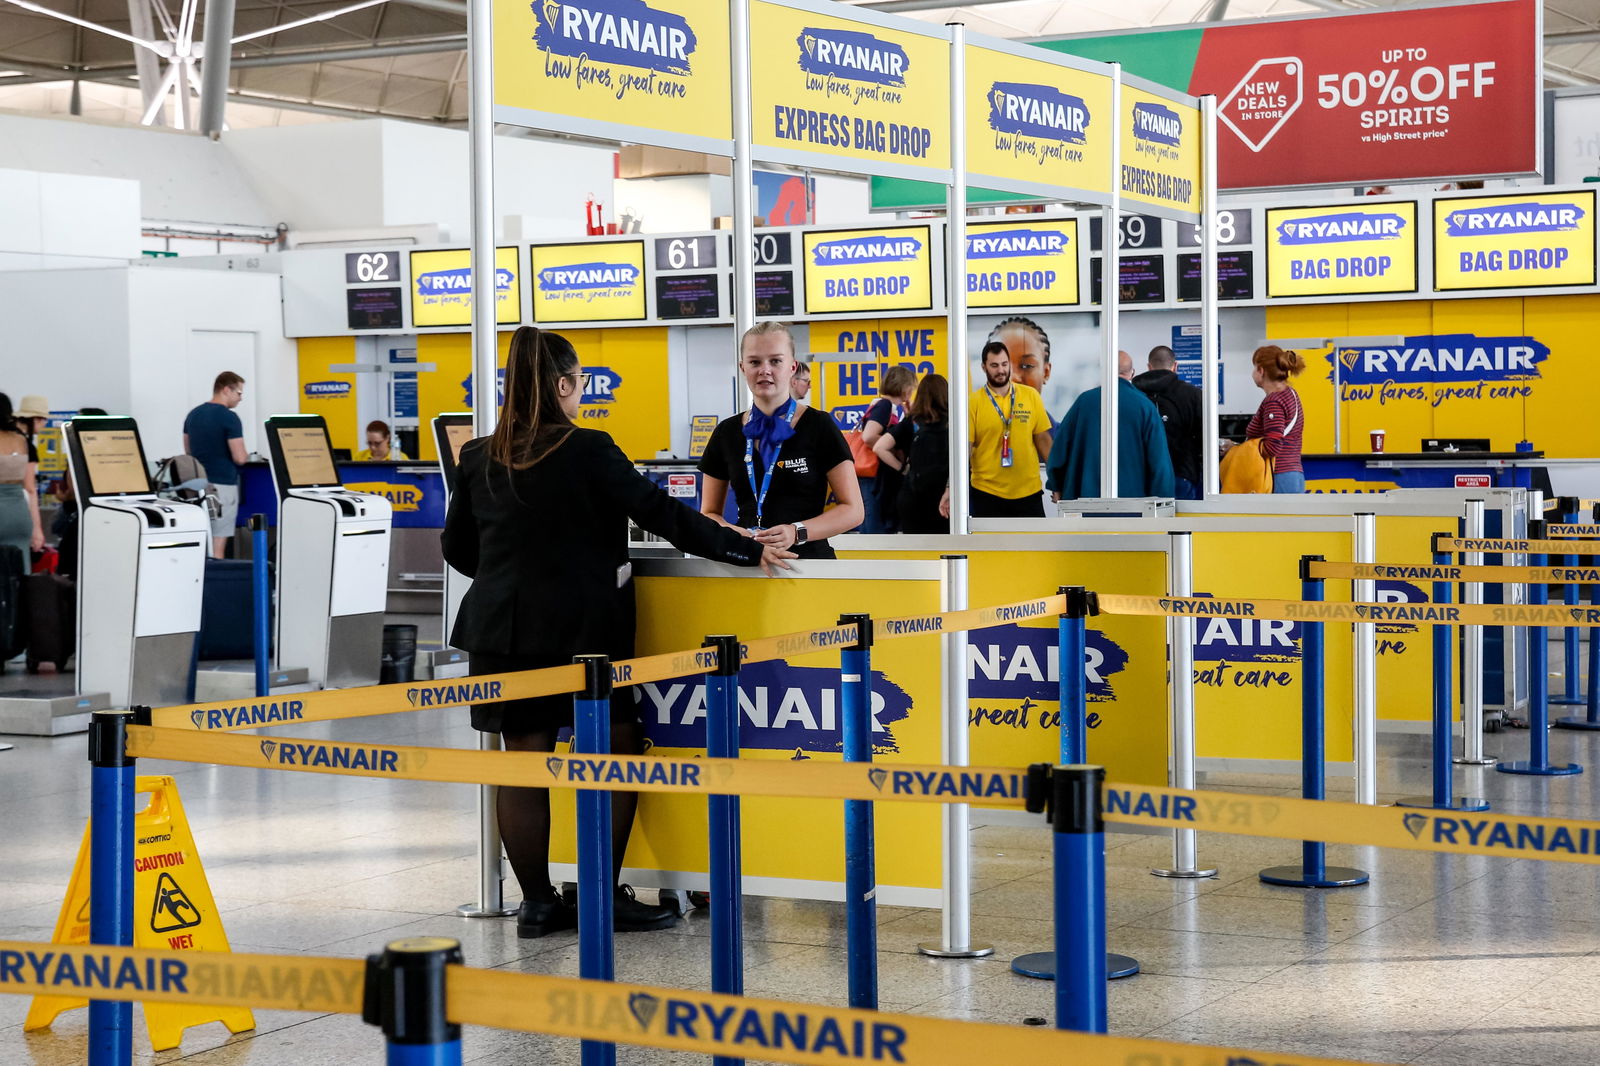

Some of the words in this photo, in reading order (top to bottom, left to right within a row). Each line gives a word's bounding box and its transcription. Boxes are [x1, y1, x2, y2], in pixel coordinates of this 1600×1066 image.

[563, 5, 688, 61] RYANAIR
[817, 38, 903, 77] RYANAIR
[1382, 49, 1404, 63] UP
[1405, 47, 1427, 61] TO
[544, 46, 572, 79] Low
[575, 52, 614, 90] fares,
[616, 68, 657, 100] great
[658, 79, 687, 98] care
[805, 68, 824, 91] Low
[826, 72, 852, 98] fares,
[853, 82, 881, 105] great
[881, 90, 903, 104] care
[1244, 81, 1280, 96] NEW
[1006, 93, 1084, 133] RYANAIR
[1237, 95, 1288, 111] DEALS
[1141, 111, 1180, 139] RYANAIR
[1241, 112, 1253, 121] IN
[1254, 110, 1284, 120] STORE
[1360, 105, 1450, 129] SPIRITS
[774, 104, 850, 148] EXPRESS
[854, 117, 886, 153] BAG
[889, 123, 931, 158] DROP
[1372, 132, 1392, 143] High
[1393, 130, 1421, 141] Street
[995, 126, 1011, 150] Low
[1014, 130, 1038, 158] fares,
[1038, 141, 1064, 165] great
[1064, 149, 1083, 163] care
[1121, 164, 1156, 194] EXPRESS
[1157, 173, 1172, 199] BAG
[1173, 177, 1192, 204] DROP
[1298, 218, 1398, 239] RYANAIR
[1468, 208, 1577, 229] RYANAIR
[668, 238, 700, 269] 61
[830, 241, 915, 260] RYANAIR
[973, 235, 1062, 253] RYANAIR
[357, 253, 389, 282] 62
[1291, 258, 1331, 280] BAG
[1336, 255, 1392, 278] DROP
[1460, 250, 1503, 273] BAG
[1509, 247, 1569, 270] DROP
[554, 267, 634, 285] RYANAIR
[825, 277, 859, 298] BAG
[863, 275, 910, 296] DROP
[967, 273, 1002, 292] BAG
[1006, 270, 1056, 291] DROP
[545, 289, 560, 301] Low
[587, 286, 612, 302] great
[613, 288, 632, 298] care
[838, 330, 889, 357] CAN
[895, 329, 935, 357] WE
[1364, 345, 1536, 374] RYANAIR
[1341, 380, 1374, 402] Low
[1378, 379, 1428, 406] fares,
[1435, 380, 1484, 407] great
[1489, 383, 1533, 399] care
[582, 408, 610, 419] care
[1550, 526, 1600, 534] RYANAI
[1464, 541, 1529, 551] RYANAIR
[1386, 566, 1461, 579] RYANAIR
[1002, 602, 1046, 619] RYANAIR
[1172, 601, 1255, 616] RYANAIR
[1370, 606, 1460, 621] RYANAIR
[894, 617, 943, 634] RYANAIR
[1234, 666, 1293, 687] care
[420, 681, 504, 707] RYANAIR
[207, 700, 303, 729] RYANAIR
[1040, 711, 1102, 729] cae
[279, 743, 398, 773] RYANAIR
[568, 759, 700, 786] RYANAIR
[1433, 817, 1600, 856] RYANAI
[134, 852, 184, 872] CAUTION
[168, 934, 193, 950] WET
[0, 950, 188, 993] RYANAIR
[665, 999, 907, 1063] RYANAIR
